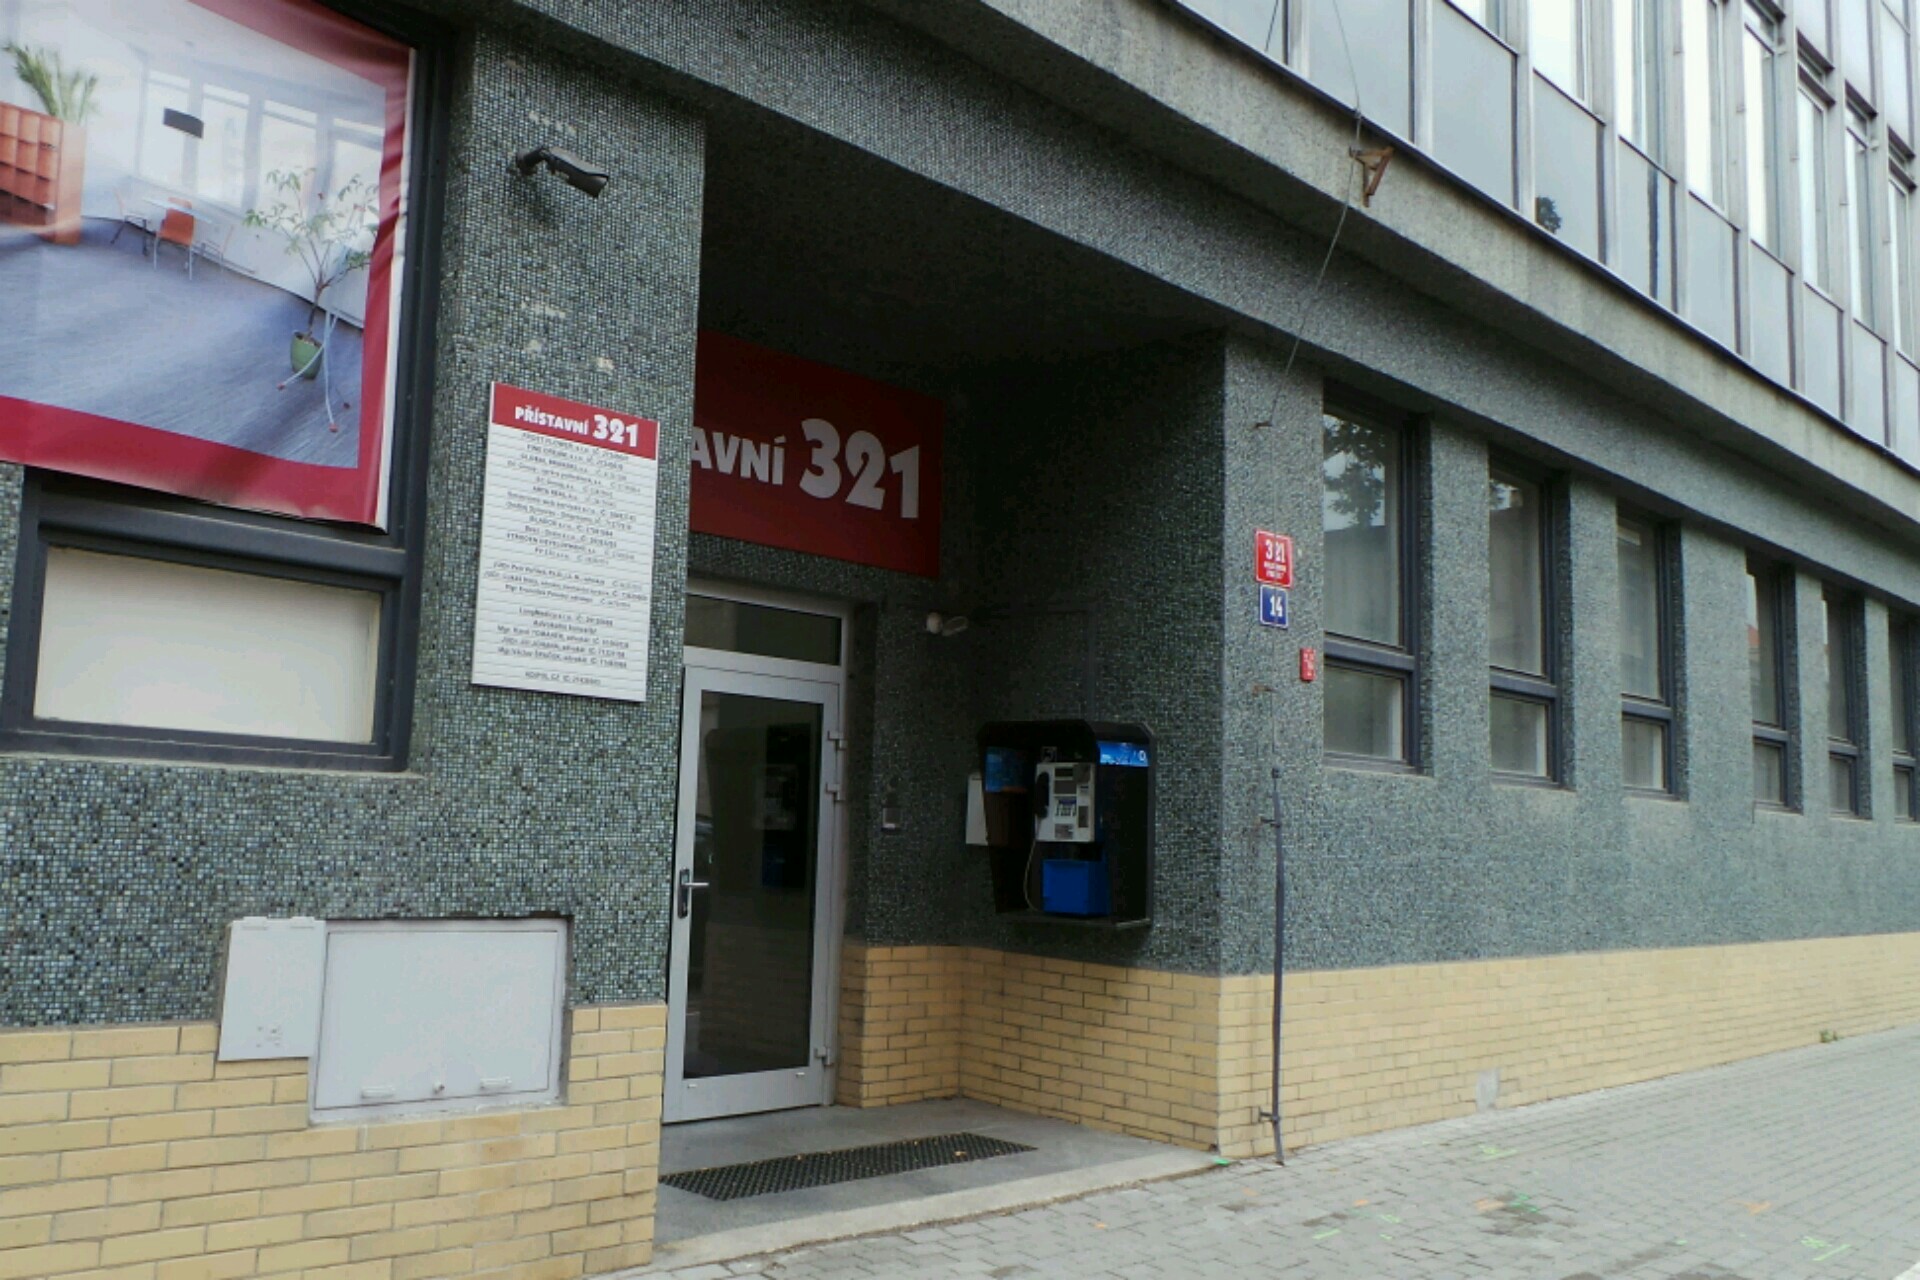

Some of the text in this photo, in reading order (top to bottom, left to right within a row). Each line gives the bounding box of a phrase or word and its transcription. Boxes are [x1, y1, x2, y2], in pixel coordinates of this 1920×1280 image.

[515, 405, 639, 447] PŘÍSTAVNÍ 321
[799, 418, 919, 518] 321
[1265, 539, 1285, 563] 321
[1269, 595, 1283, 617] 14
